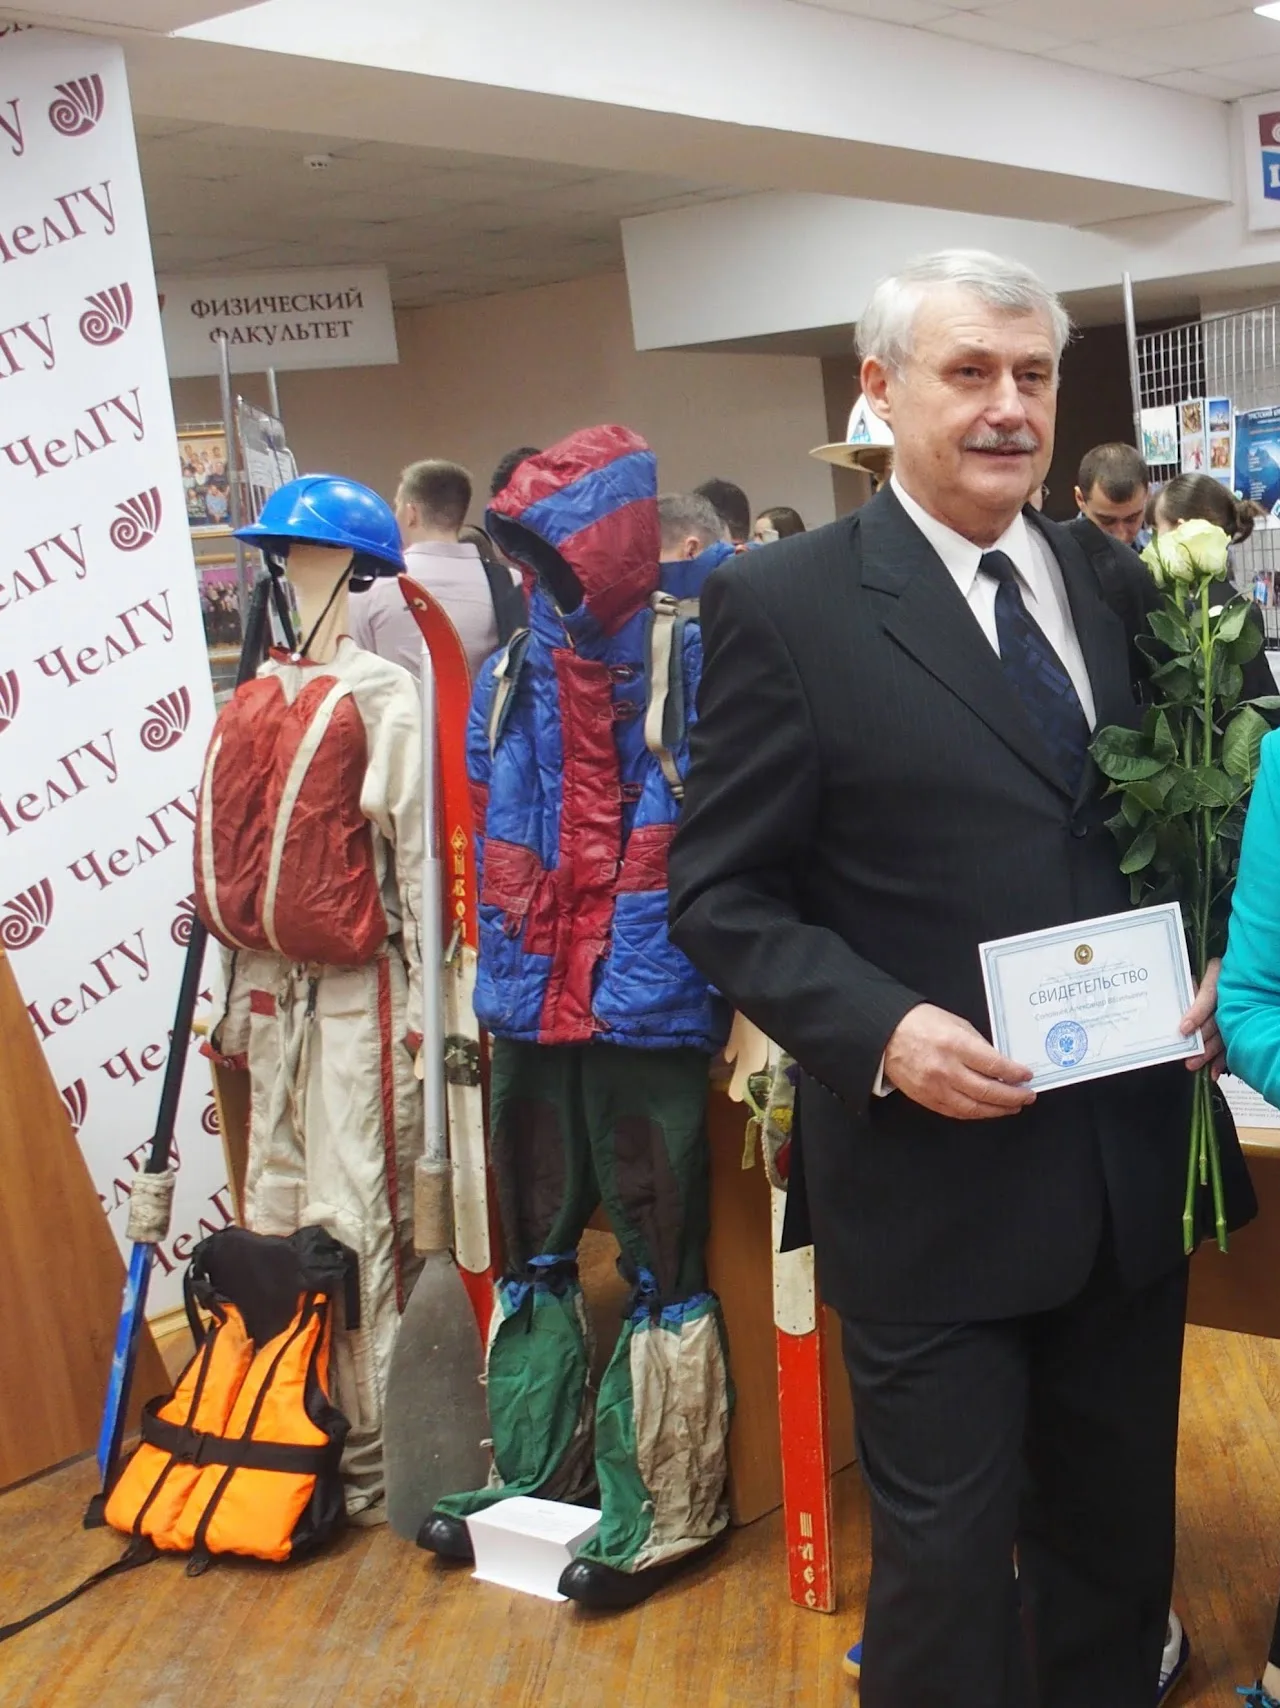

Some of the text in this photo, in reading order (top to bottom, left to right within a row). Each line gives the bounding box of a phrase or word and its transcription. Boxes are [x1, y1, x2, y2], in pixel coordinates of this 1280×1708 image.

[190, 287, 365, 319] ФИЗИЧЕСКИЙ
[208, 320, 353, 346] ФАКУЛЬТЕТ
[0, 387, 145, 478] ЧелГУ
[33, 588, 174, 687] ЧелГУ
[1029, 967, 1149, 1006] СВИДЕТЕЛЬСТВО
